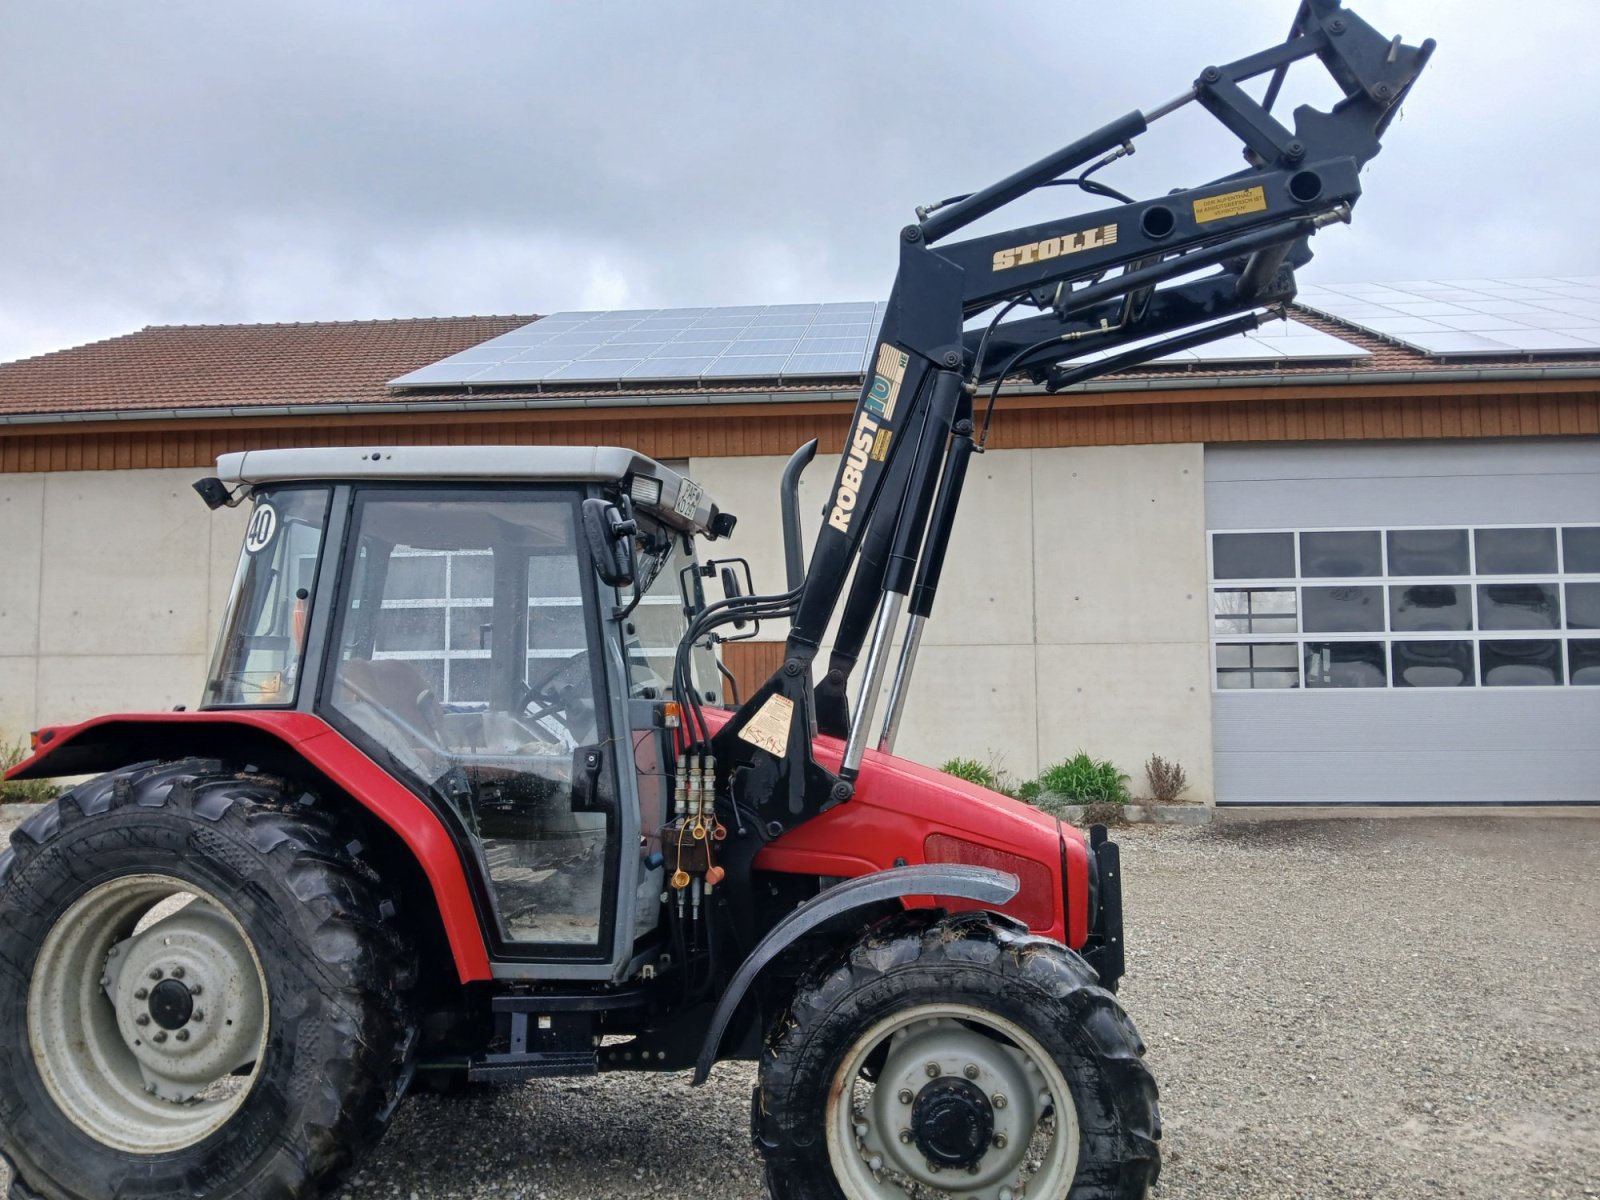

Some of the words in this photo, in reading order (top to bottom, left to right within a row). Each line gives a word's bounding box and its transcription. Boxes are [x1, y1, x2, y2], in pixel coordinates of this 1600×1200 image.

[993, 228, 1103, 271] STOLL
[829, 411, 878, 533] ROBUST
[864, 375, 892, 413] 10
[248, 510, 272, 545] 40
